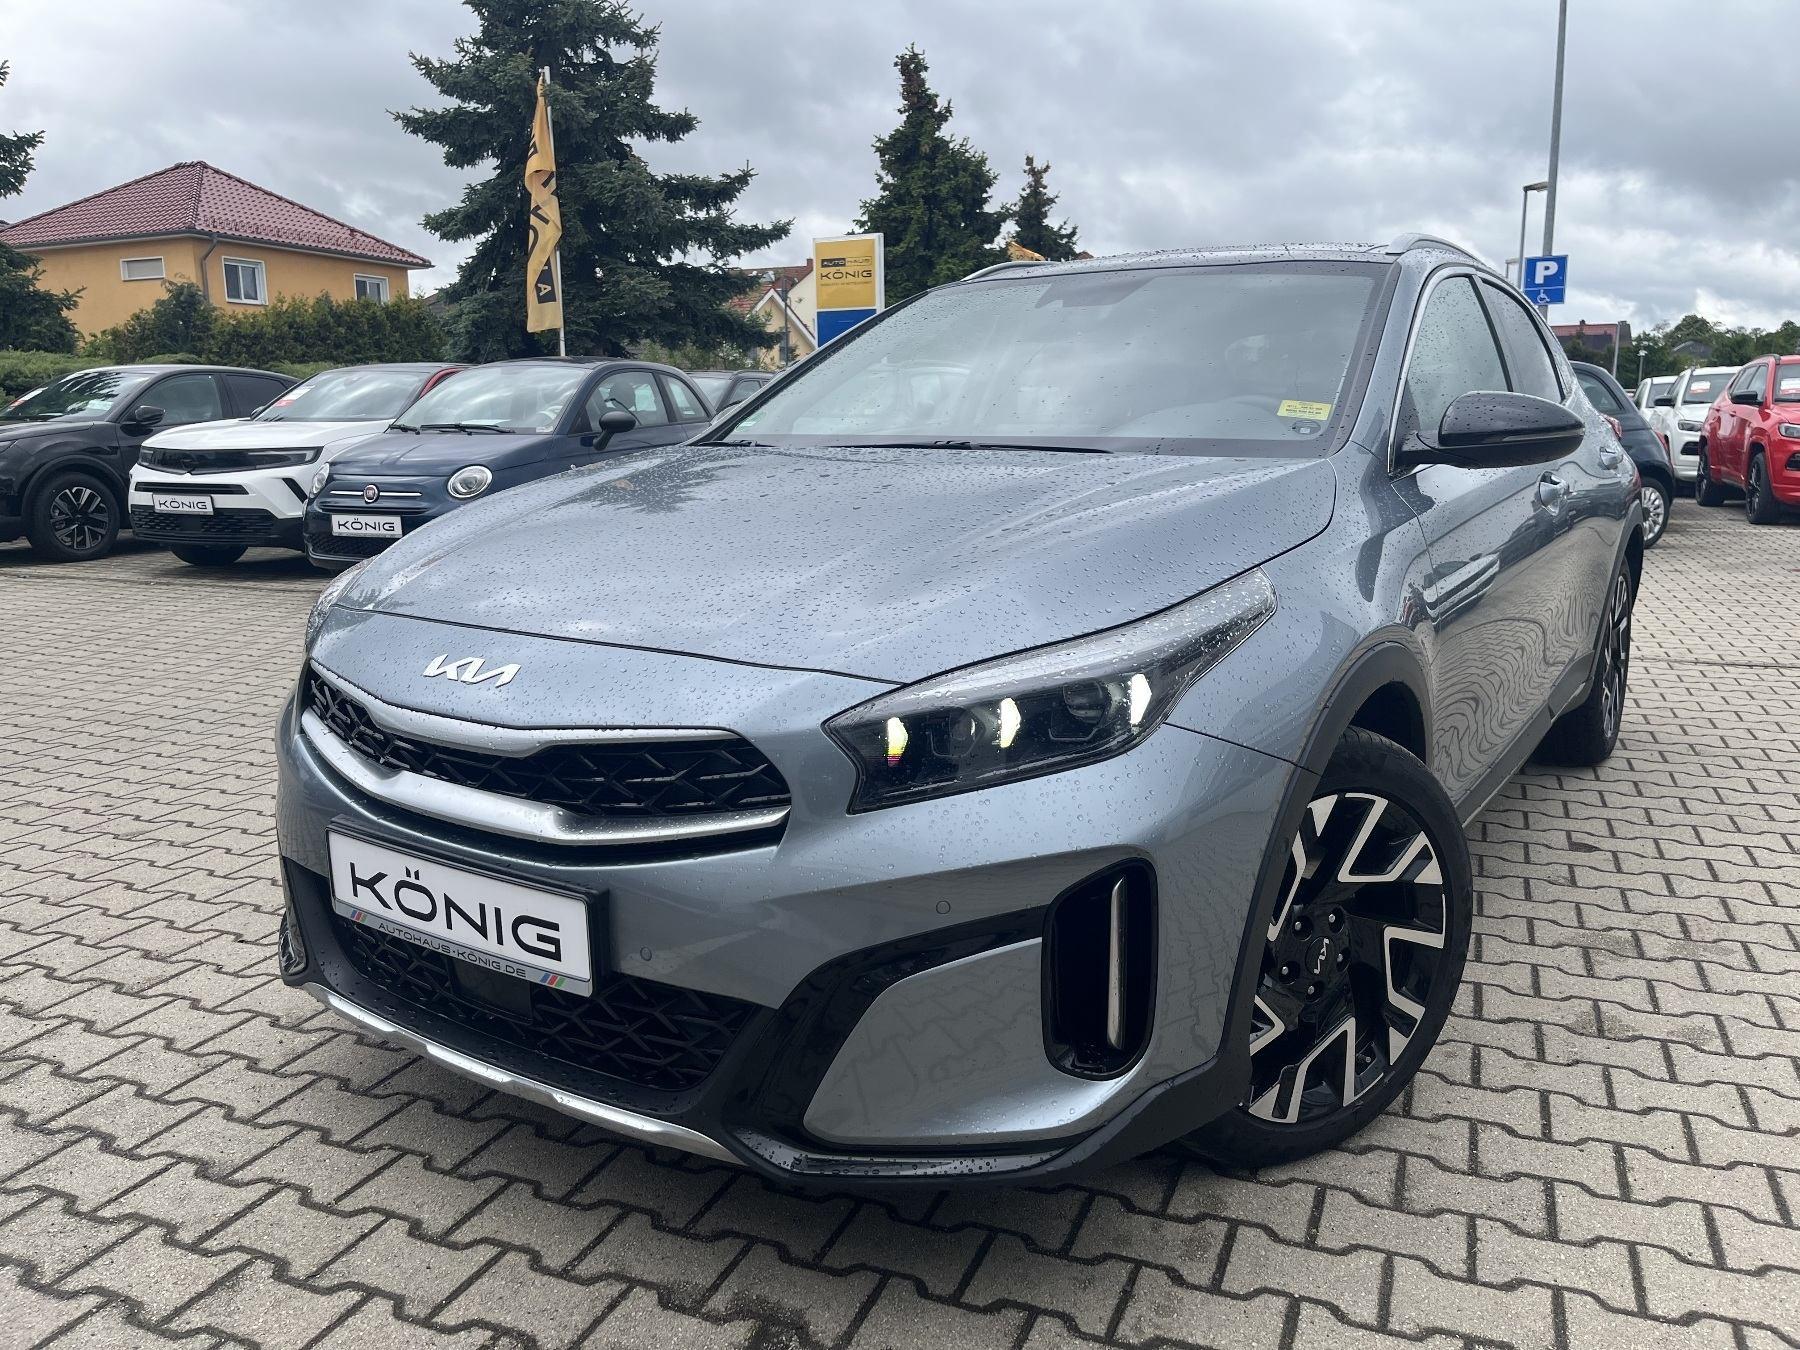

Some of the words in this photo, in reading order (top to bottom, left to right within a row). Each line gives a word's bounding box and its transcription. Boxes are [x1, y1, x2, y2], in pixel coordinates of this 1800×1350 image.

[820, 268, 873, 280] KÖNIG
[1534, 260, 1559, 285] P
[158, 498, 208, 510] KÖNIG
[337, 517, 395, 532] KÖNIG
[422, 653, 522, 689] KIA
[349, 861, 562, 963] KÖNIG
